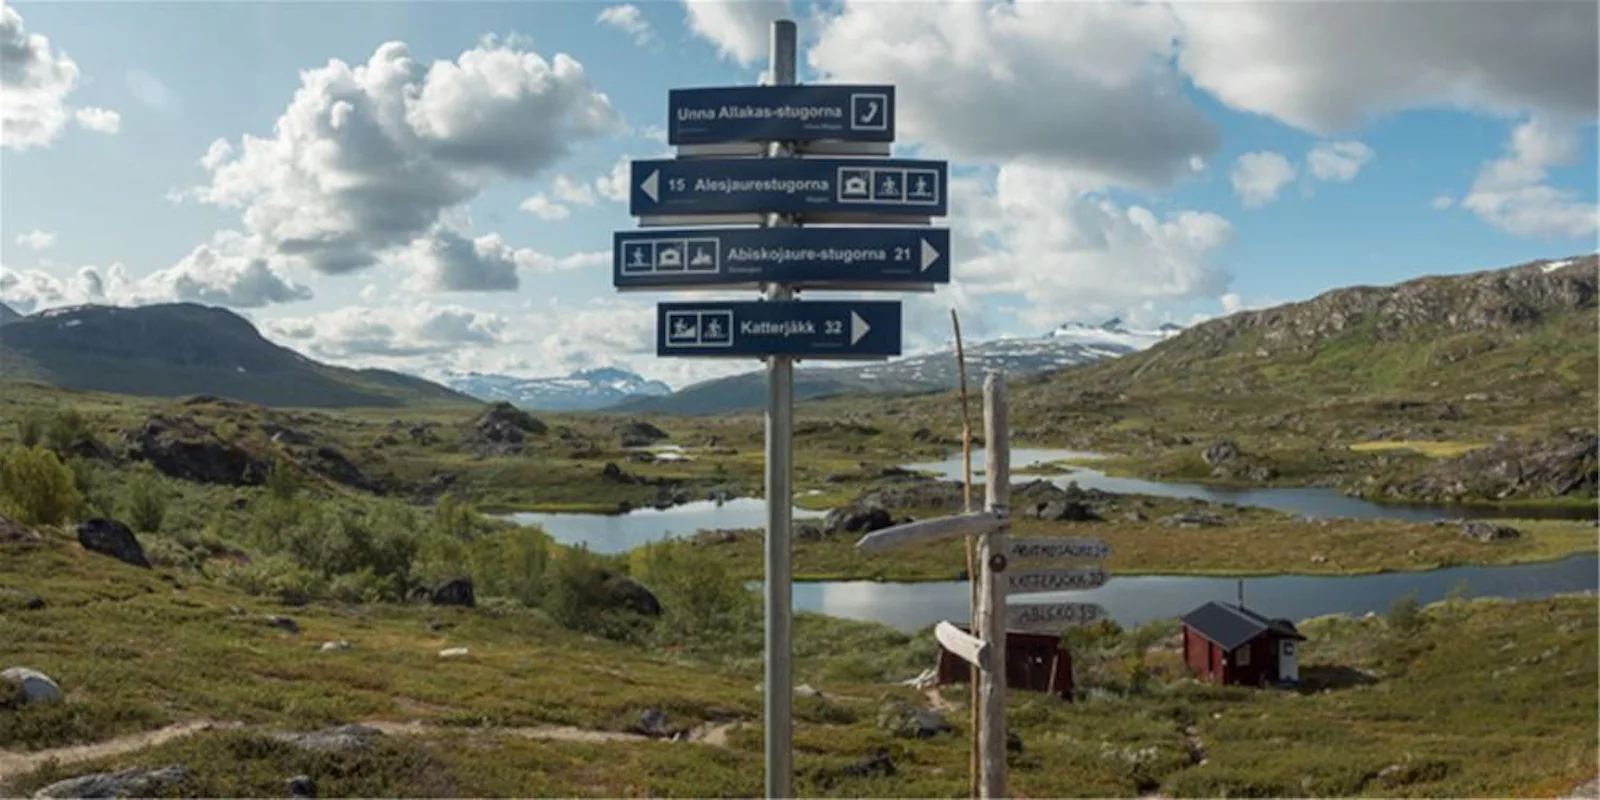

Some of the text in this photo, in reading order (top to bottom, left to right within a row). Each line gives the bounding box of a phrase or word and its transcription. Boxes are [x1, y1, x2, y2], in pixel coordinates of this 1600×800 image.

[677, 104, 843, 121] Unna Allakas-stugorna
[668, 177, 829, 194] 15 Alesjaurestugorna
[727, 246, 911, 263] Abiskojaure-stugorna 21
[740, 319, 844, 338] Katterjåkk 32
